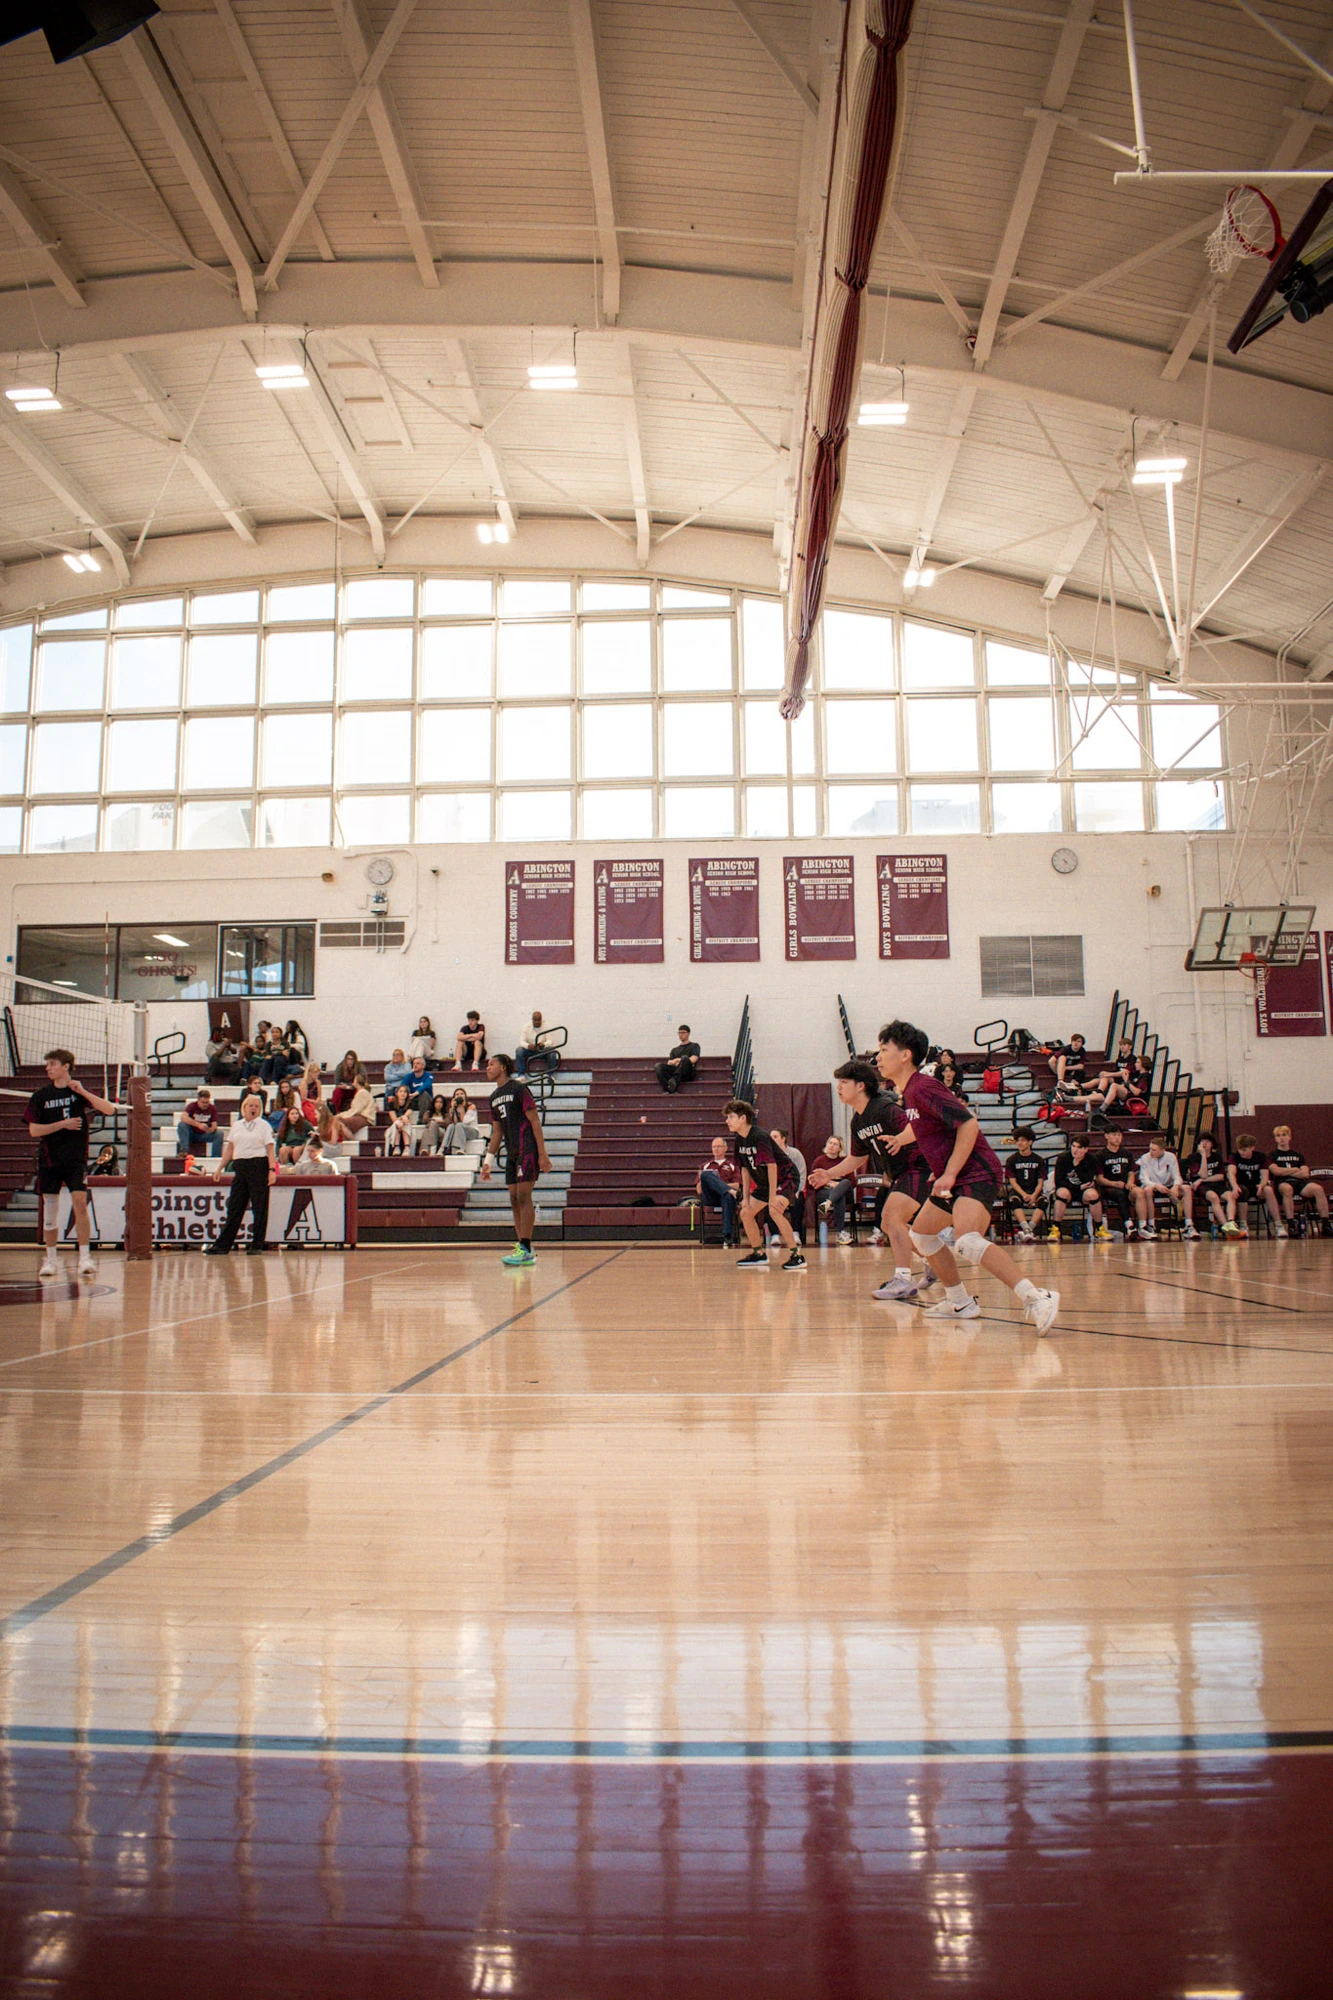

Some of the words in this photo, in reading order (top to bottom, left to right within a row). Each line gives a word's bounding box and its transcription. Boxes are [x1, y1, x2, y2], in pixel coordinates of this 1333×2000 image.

[524, 864, 571, 873] ABINGTON
[612, 862, 660, 872] ABINGTON
[707, 861, 755, 870] ABINGTON
[802, 859, 850, 868] ABINGTON
[895, 858, 943, 867] ABINGTON
[510, 889, 518, 919] COUNTRY
[788, 882, 797, 926] BOWLING
[882, 884, 890, 928] BOWLING
[790, 929, 798, 957] GIRLS
[883, 932, 891, 956] BOYS
[1278, 934, 1316, 944] INGTON
[221, 1012, 231, 1028] A
[1260, 1014, 1268, 1034] BOYS
[44, 1095, 78, 1109] ABING
[121, 1189, 252, 1216] bingt
[284, 1188, 322, 1240] A
